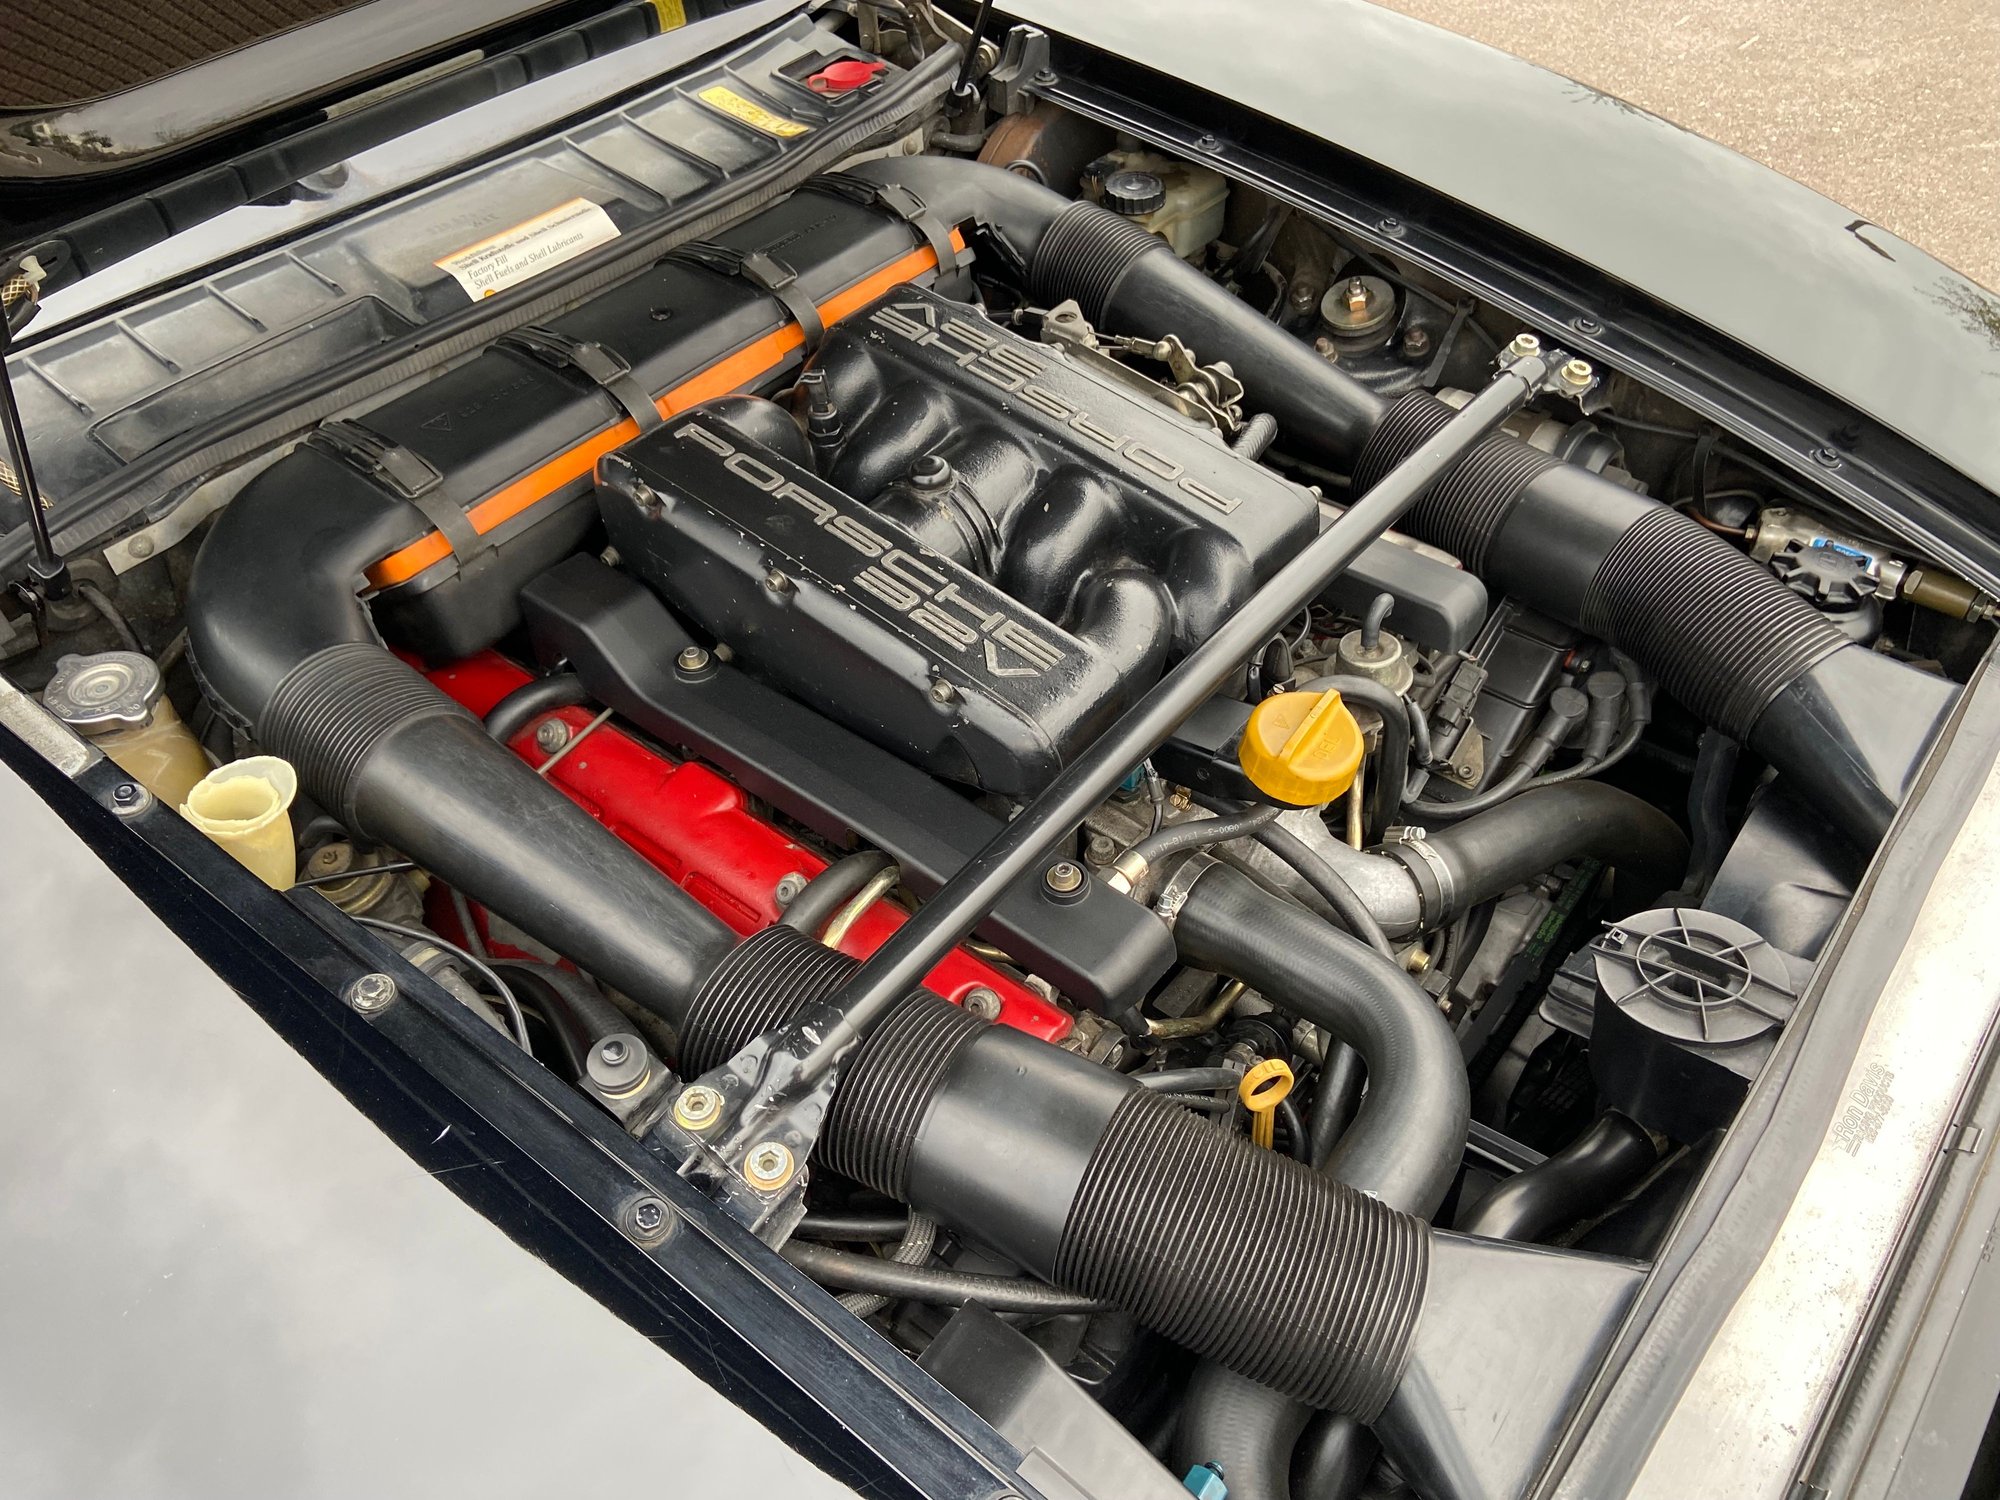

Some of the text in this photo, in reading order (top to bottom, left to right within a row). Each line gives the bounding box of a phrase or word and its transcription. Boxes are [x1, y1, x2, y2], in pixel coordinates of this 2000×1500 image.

[467, 262, 496, 280] Factory
[494, 254, 508, 267] Fill
[473, 232, 584, 290] Shell Fuels and Shell Lubricants
[868, 306, 1242, 516] PORSCHE
[673, 422, 1066, 671] PORSCHE
[852, 565, 1042, 678] 32V
[1832, 1105, 1863, 1142] Ron
[1849, 1062, 1885, 1108] Davis
